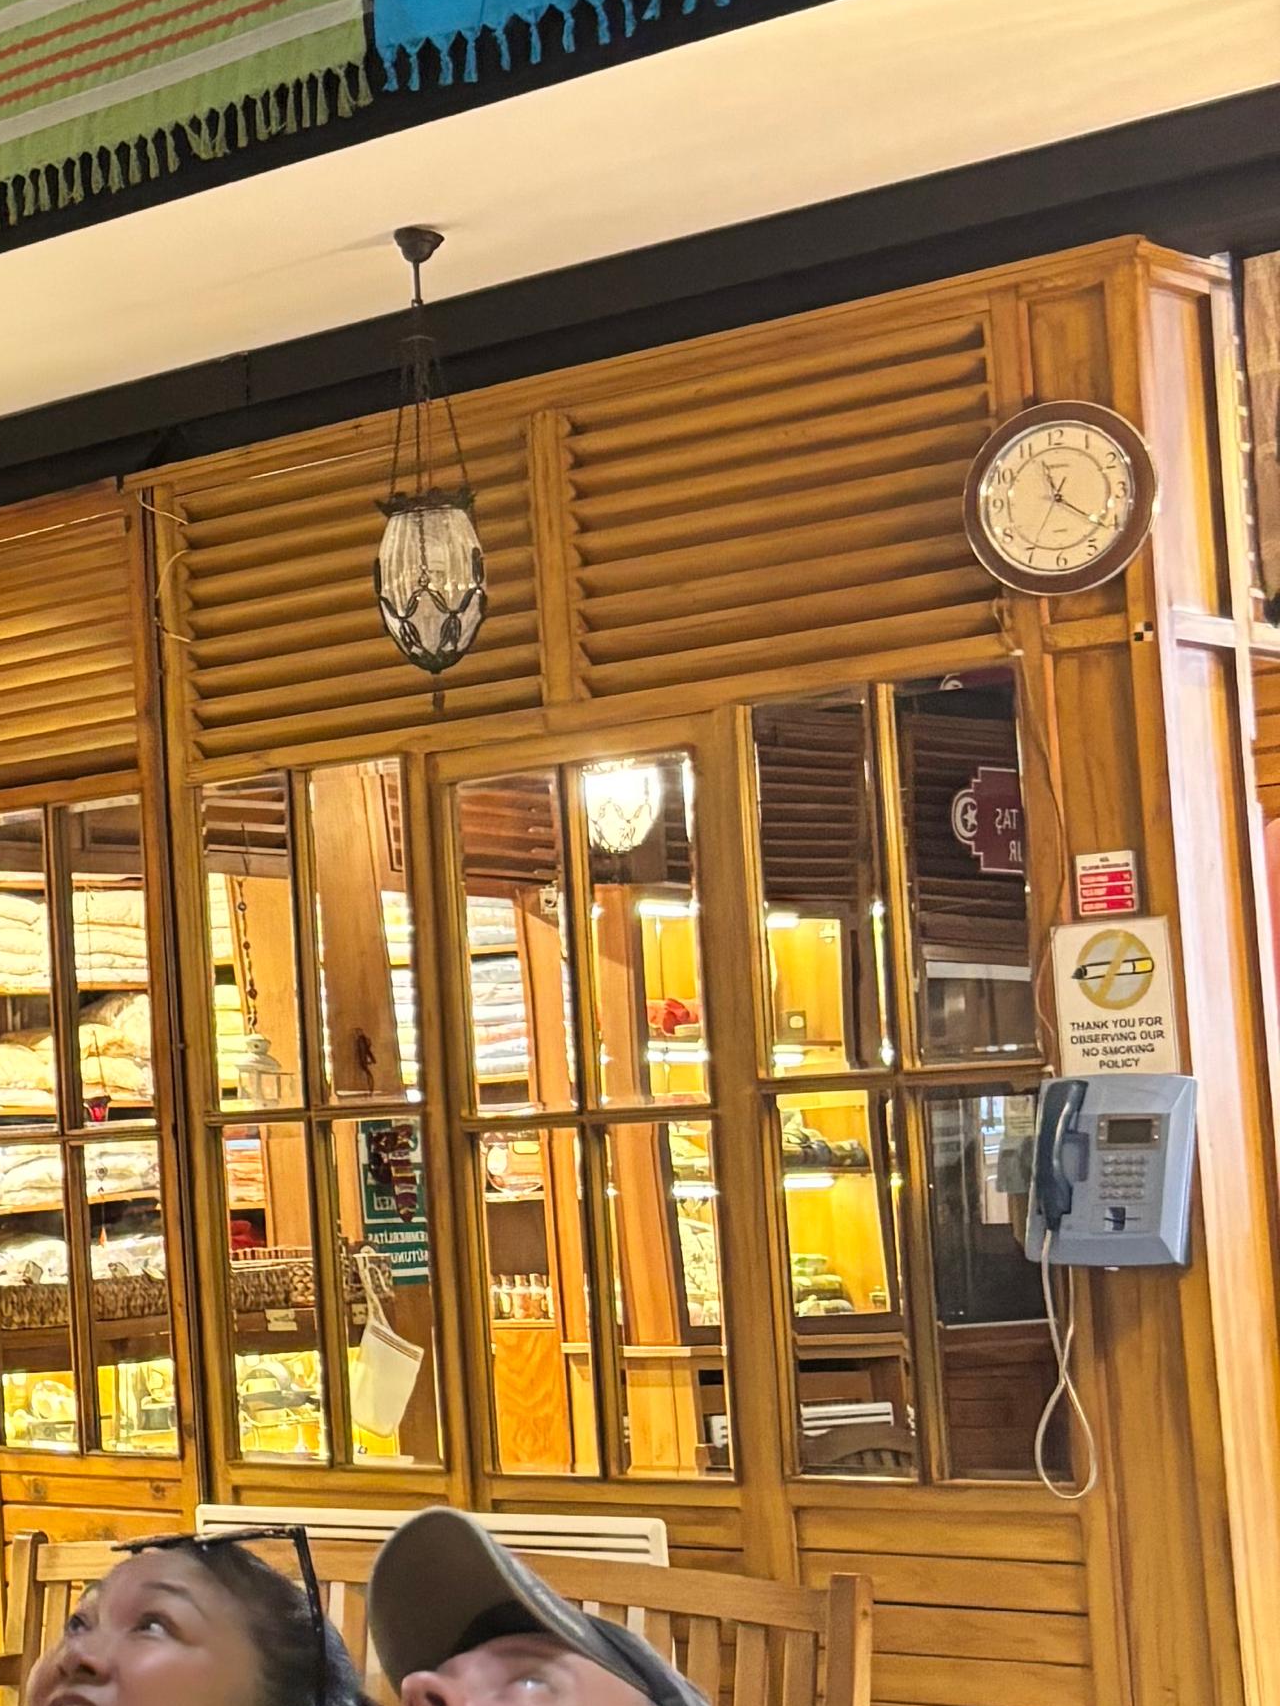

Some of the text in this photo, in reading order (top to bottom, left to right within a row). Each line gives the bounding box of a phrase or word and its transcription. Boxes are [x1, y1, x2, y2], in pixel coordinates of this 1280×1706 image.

[1047, 429, 1064, 446] 12
[1019, 443, 1033, 459] 11
[1105, 451, 1117, 469] 2
[997, 468, 1014, 485] 10
[1115, 481, 1127, 499] 3
[992, 498, 1004, 513] 9
[1002, 527, 1014, 543] 8
[1086, 537, 1098, 556] 5
[1025, 546, 1036, 564] 7
[1055, 551, 1068, 567] 6
[1070, 1016, 1162, 1031] THANK YOU FOR
[1070, 1030, 1165, 1045] OBSERVING OUR
[1082, 1043, 1155, 1058] NO SMOKING
[1099, 1057, 1140, 1069] POLICY
